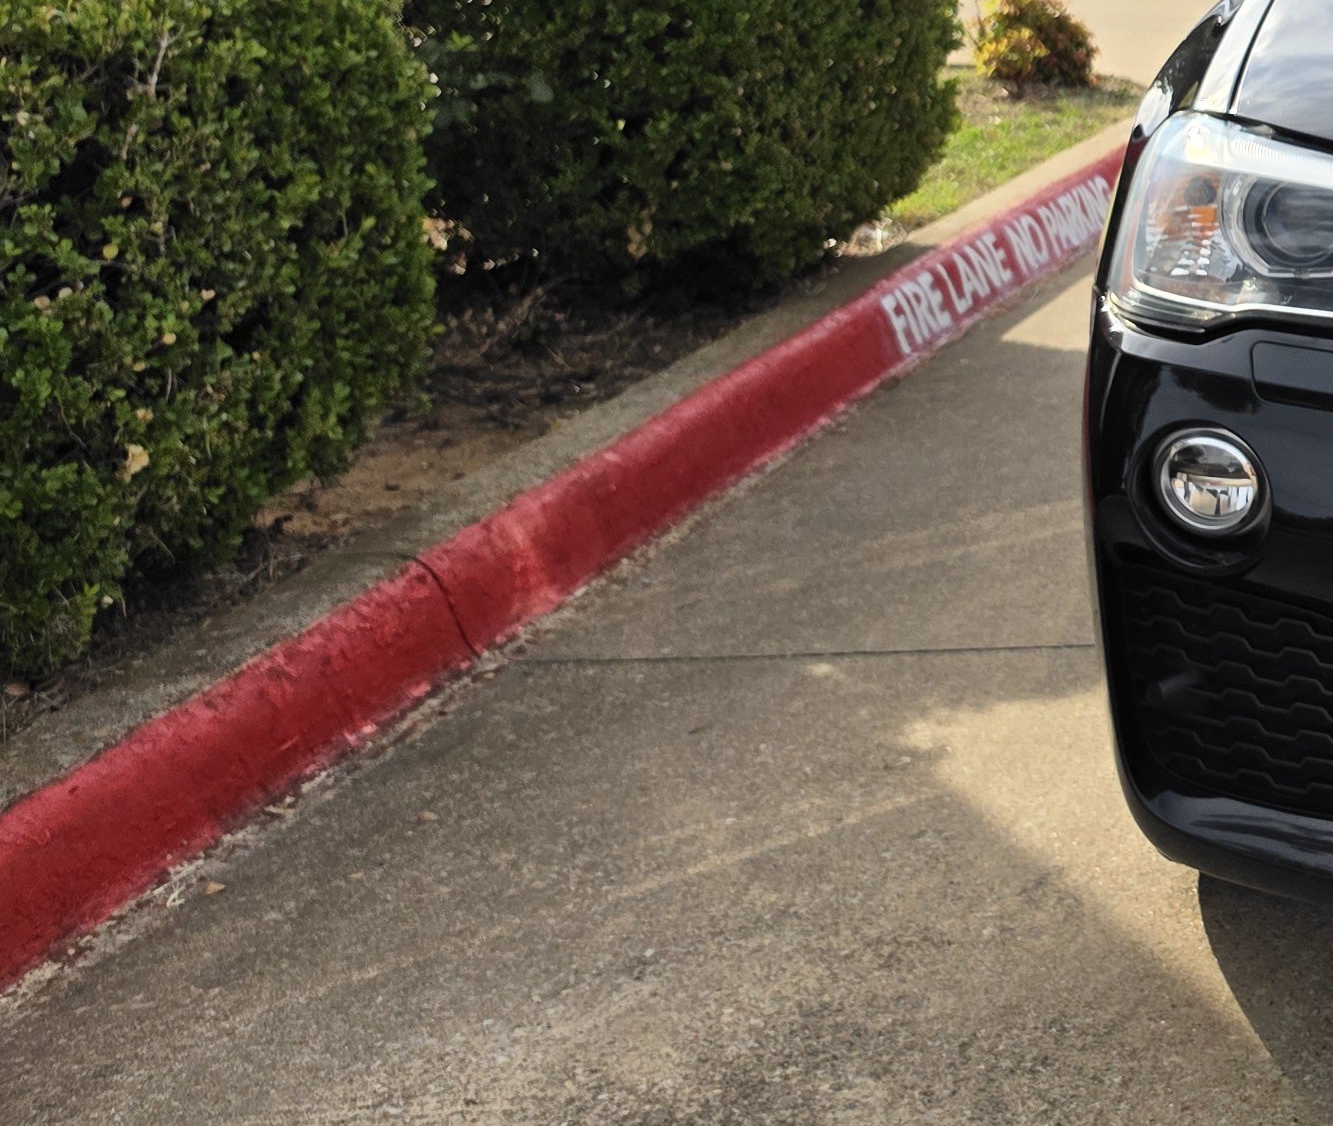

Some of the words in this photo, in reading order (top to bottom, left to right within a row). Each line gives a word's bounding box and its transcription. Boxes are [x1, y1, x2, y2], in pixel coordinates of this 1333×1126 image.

[880, 271, 952, 355] FIRE
[935, 231, 1013, 315] LANE
[1004, 214, 1051, 274] NO
